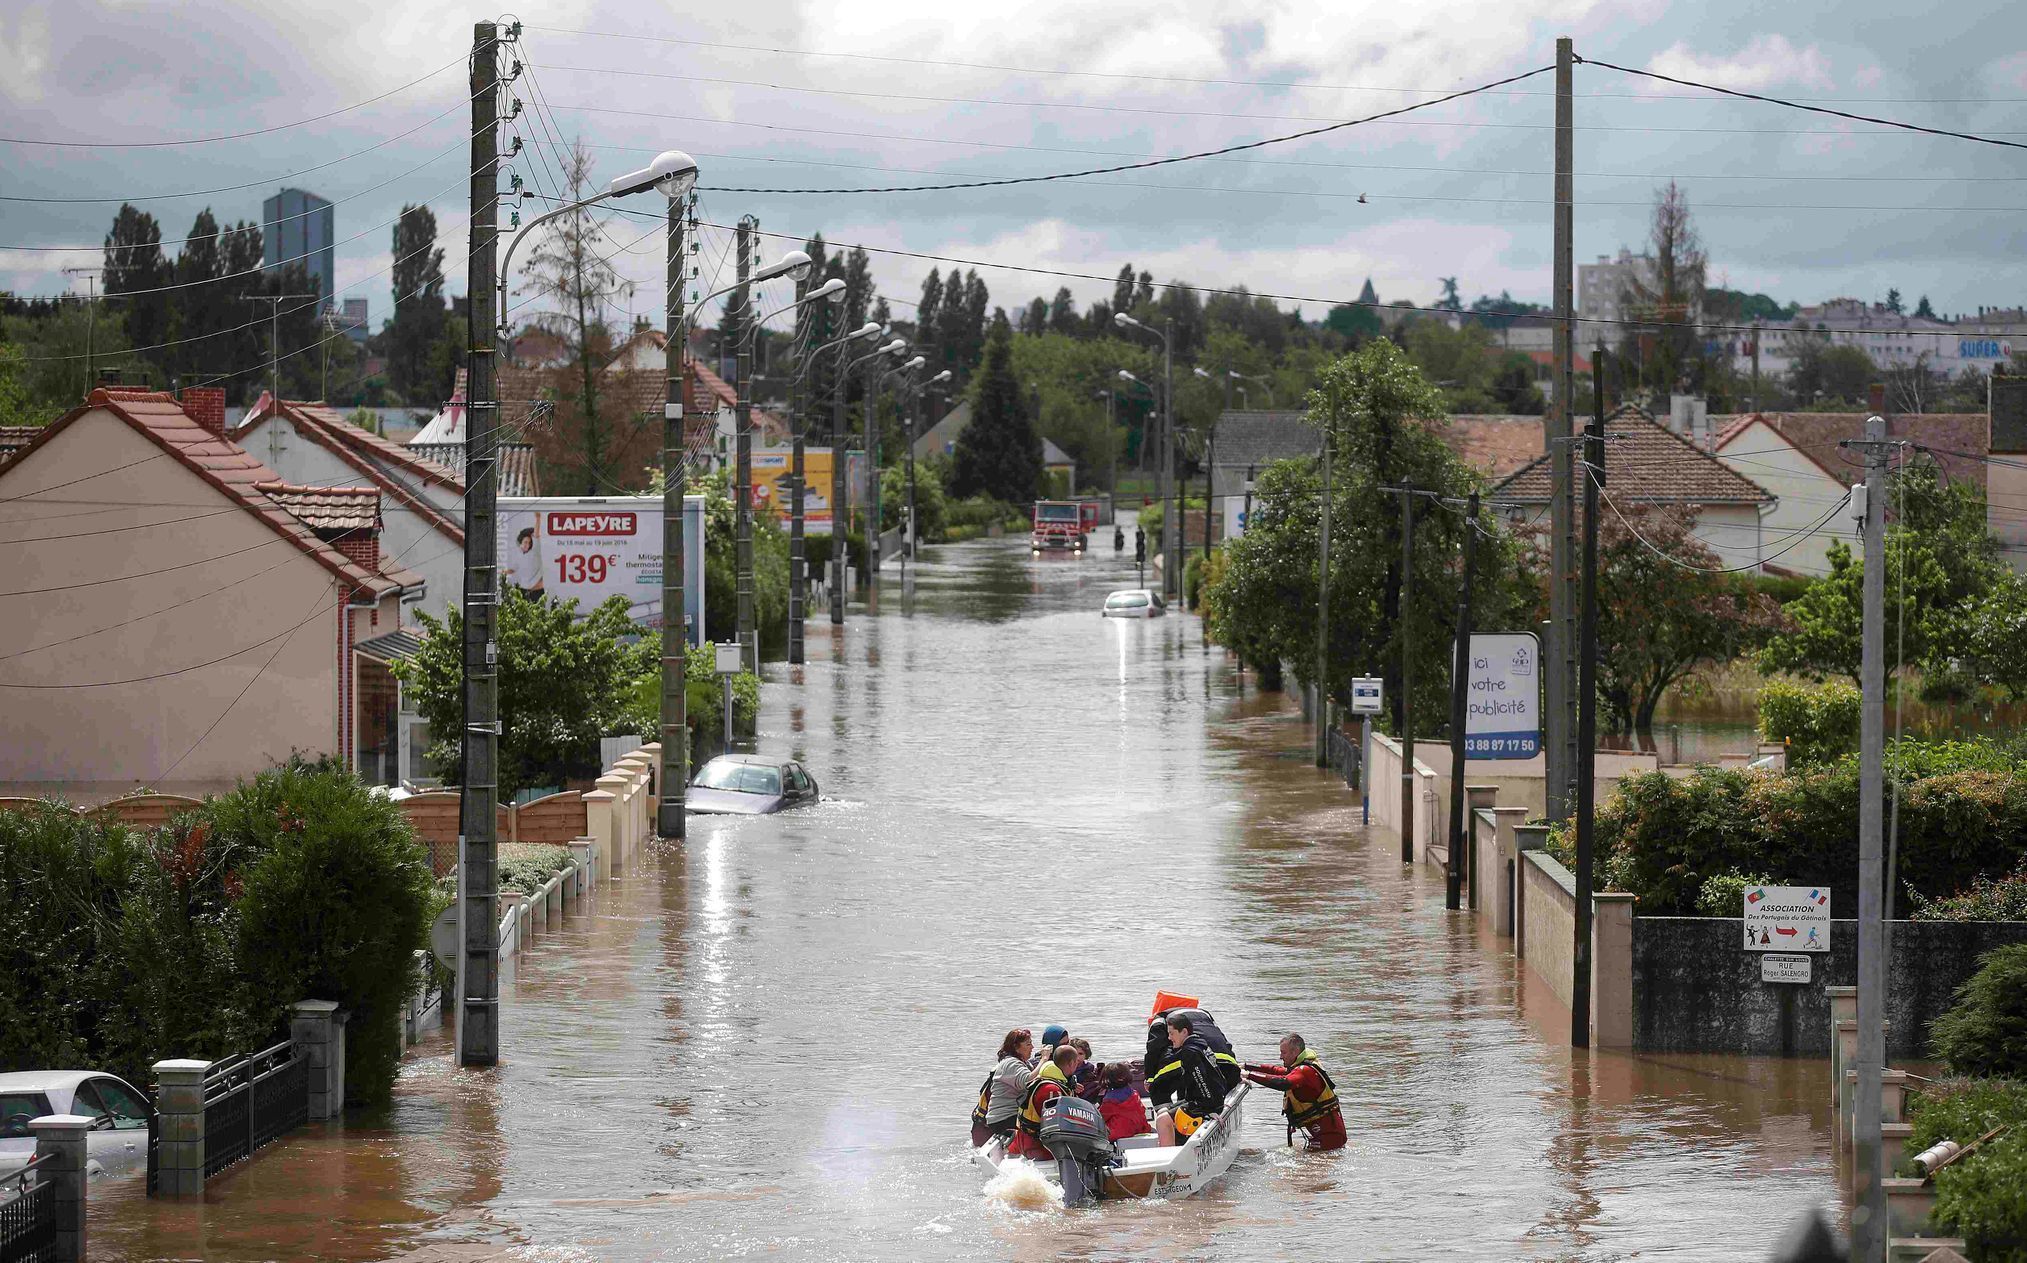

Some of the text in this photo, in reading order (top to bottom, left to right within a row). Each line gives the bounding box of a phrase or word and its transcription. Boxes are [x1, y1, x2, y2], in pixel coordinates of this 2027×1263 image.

[1960, 339, 1998, 357] SUPER
[553, 515, 631, 532] LAPEYRE
[1474, 657, 1489, 669] ici
[1471, 677, 1506, 692] votre
[1469, 699, 1526, 720] publicité
[1476, 739, 1490, 751] 88
[1491, 739, 1505, 751] 87
[1506, 739, 1520, 751] 17
[1521, 739, 1535, 751] 50
[1067, 1106, 1095, 1122] YAMAHA
